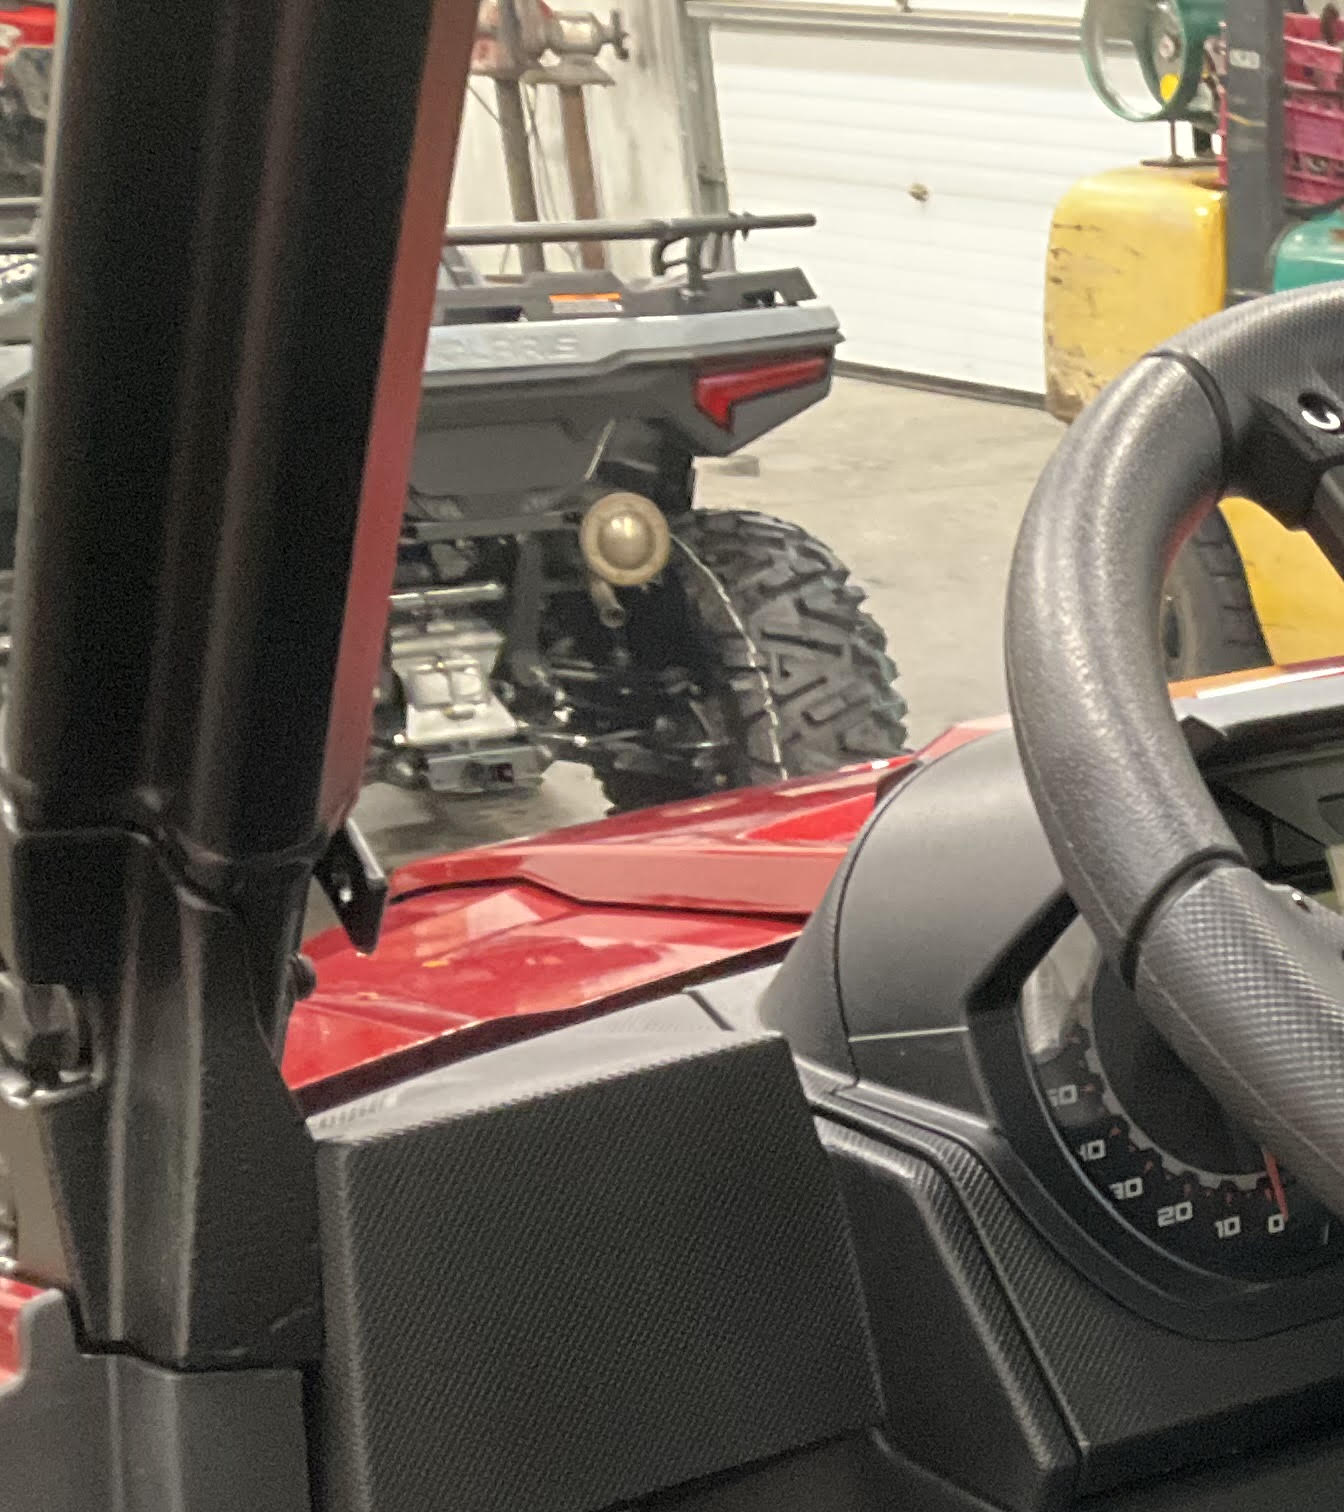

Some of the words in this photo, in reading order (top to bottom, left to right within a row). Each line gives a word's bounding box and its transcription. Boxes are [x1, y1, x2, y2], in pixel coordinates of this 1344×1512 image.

[1109, 1176, 1144, 1200] 30
[1157, 1201, 1193, 1228] 20
[1267, 1213, 1285, 1235] 0
[1214, 1215, 1242, 1238] 10
